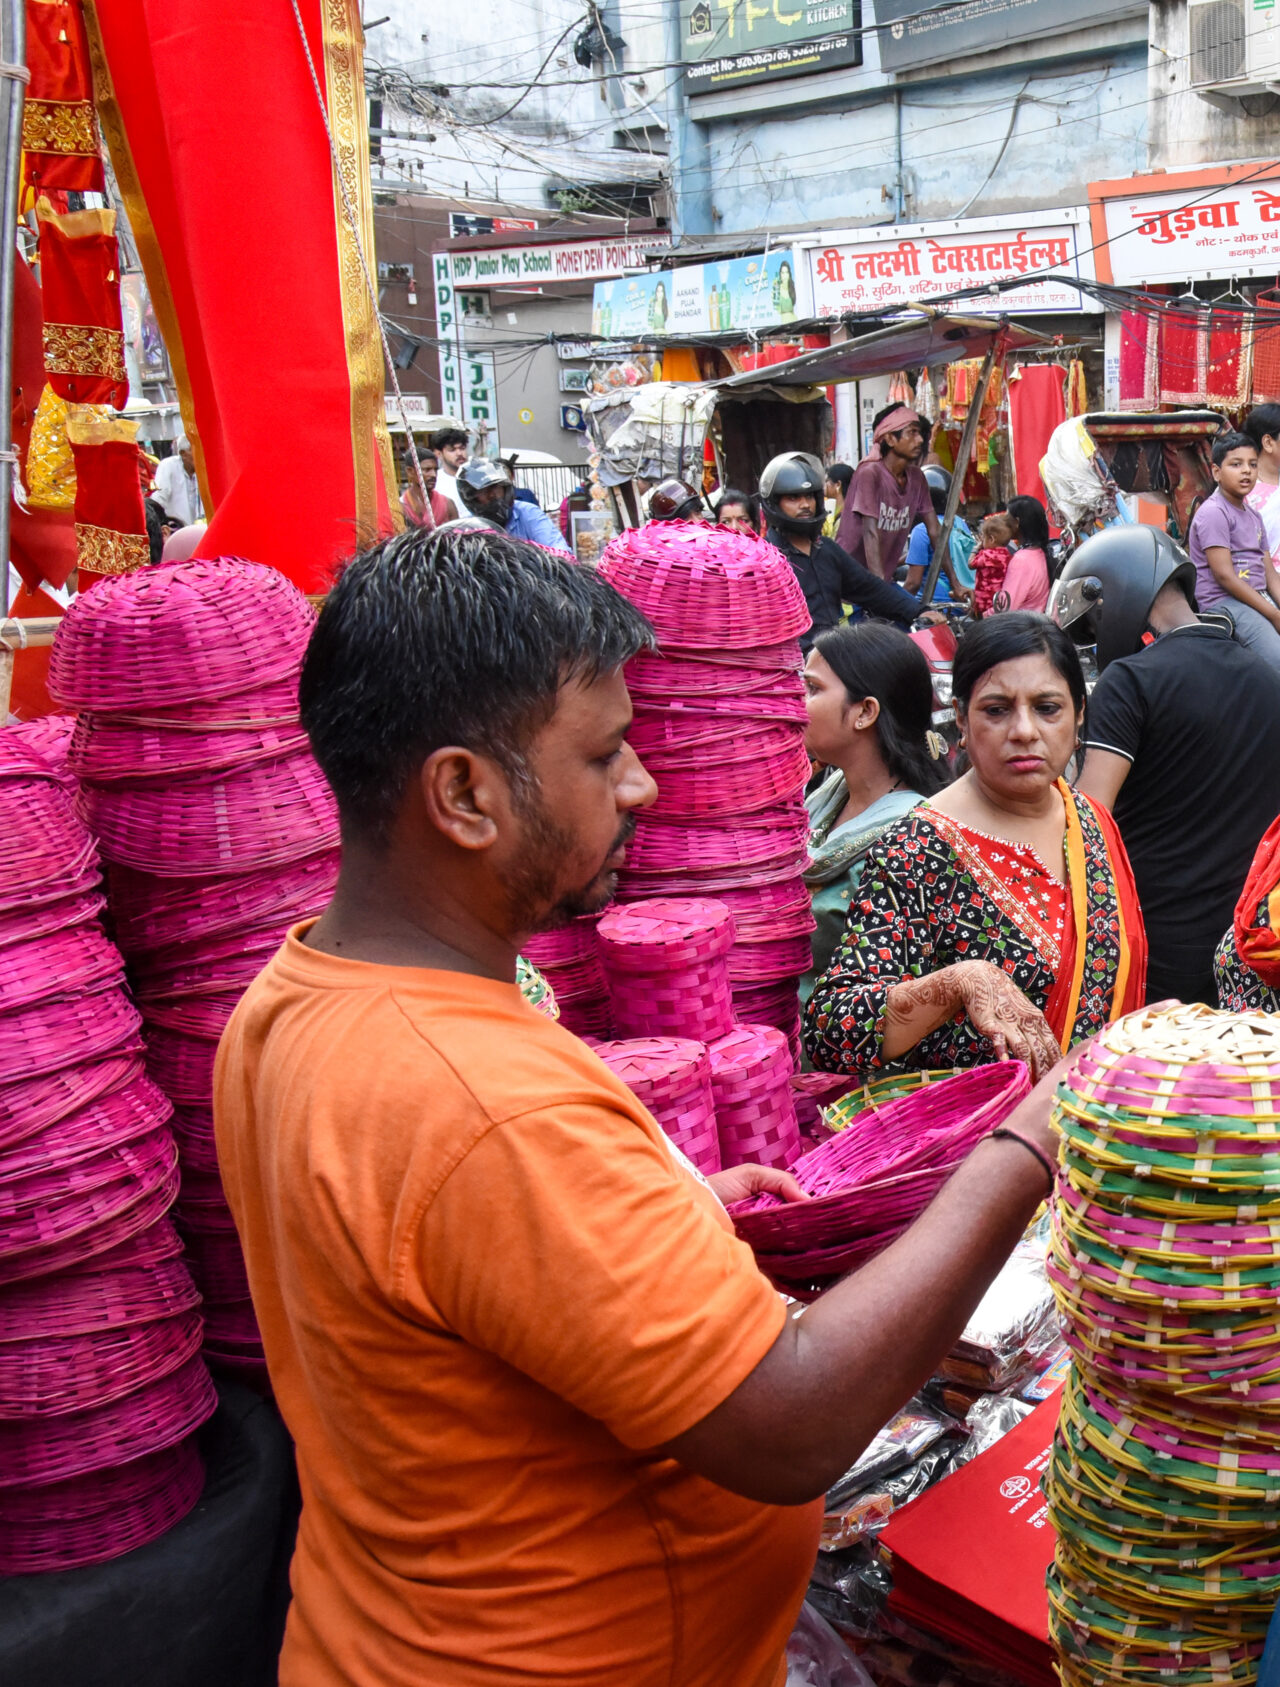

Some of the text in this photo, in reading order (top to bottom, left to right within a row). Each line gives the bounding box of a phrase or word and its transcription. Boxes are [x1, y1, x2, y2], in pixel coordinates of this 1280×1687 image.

[806, 4, 848, 25] KITCHEN
[687, 59, 720, 79] Contact
[1131, 201, 1240, 245] जुड़वा
[1195, 236, 1217, 248] नोट
[1233, 232, 1259, 244] थोक
[1262, 229, 1279, 241] एवं
[453, 256, 471, 278] HDP
[474, 254, 500, 281] Junior
[502, 253, 521, 278] Play
[523, 250, 552, 274] School
[556, 250, 583, 277] HONEY
[585, 249, 604, 272] DEW
[606, 245, 632, 272] POINT
[816, 231, 1070, 283] श्री लक्ष्मी टेक्सटाईल्स
[676, 286, 700, 297] AANAND
[945, 276, 963, 292] एवं
[680, 299, 695, 309] PUJA
[674, 308, 702, 320] BHANDAR
[395, 399, 425, 411] SHOOL
